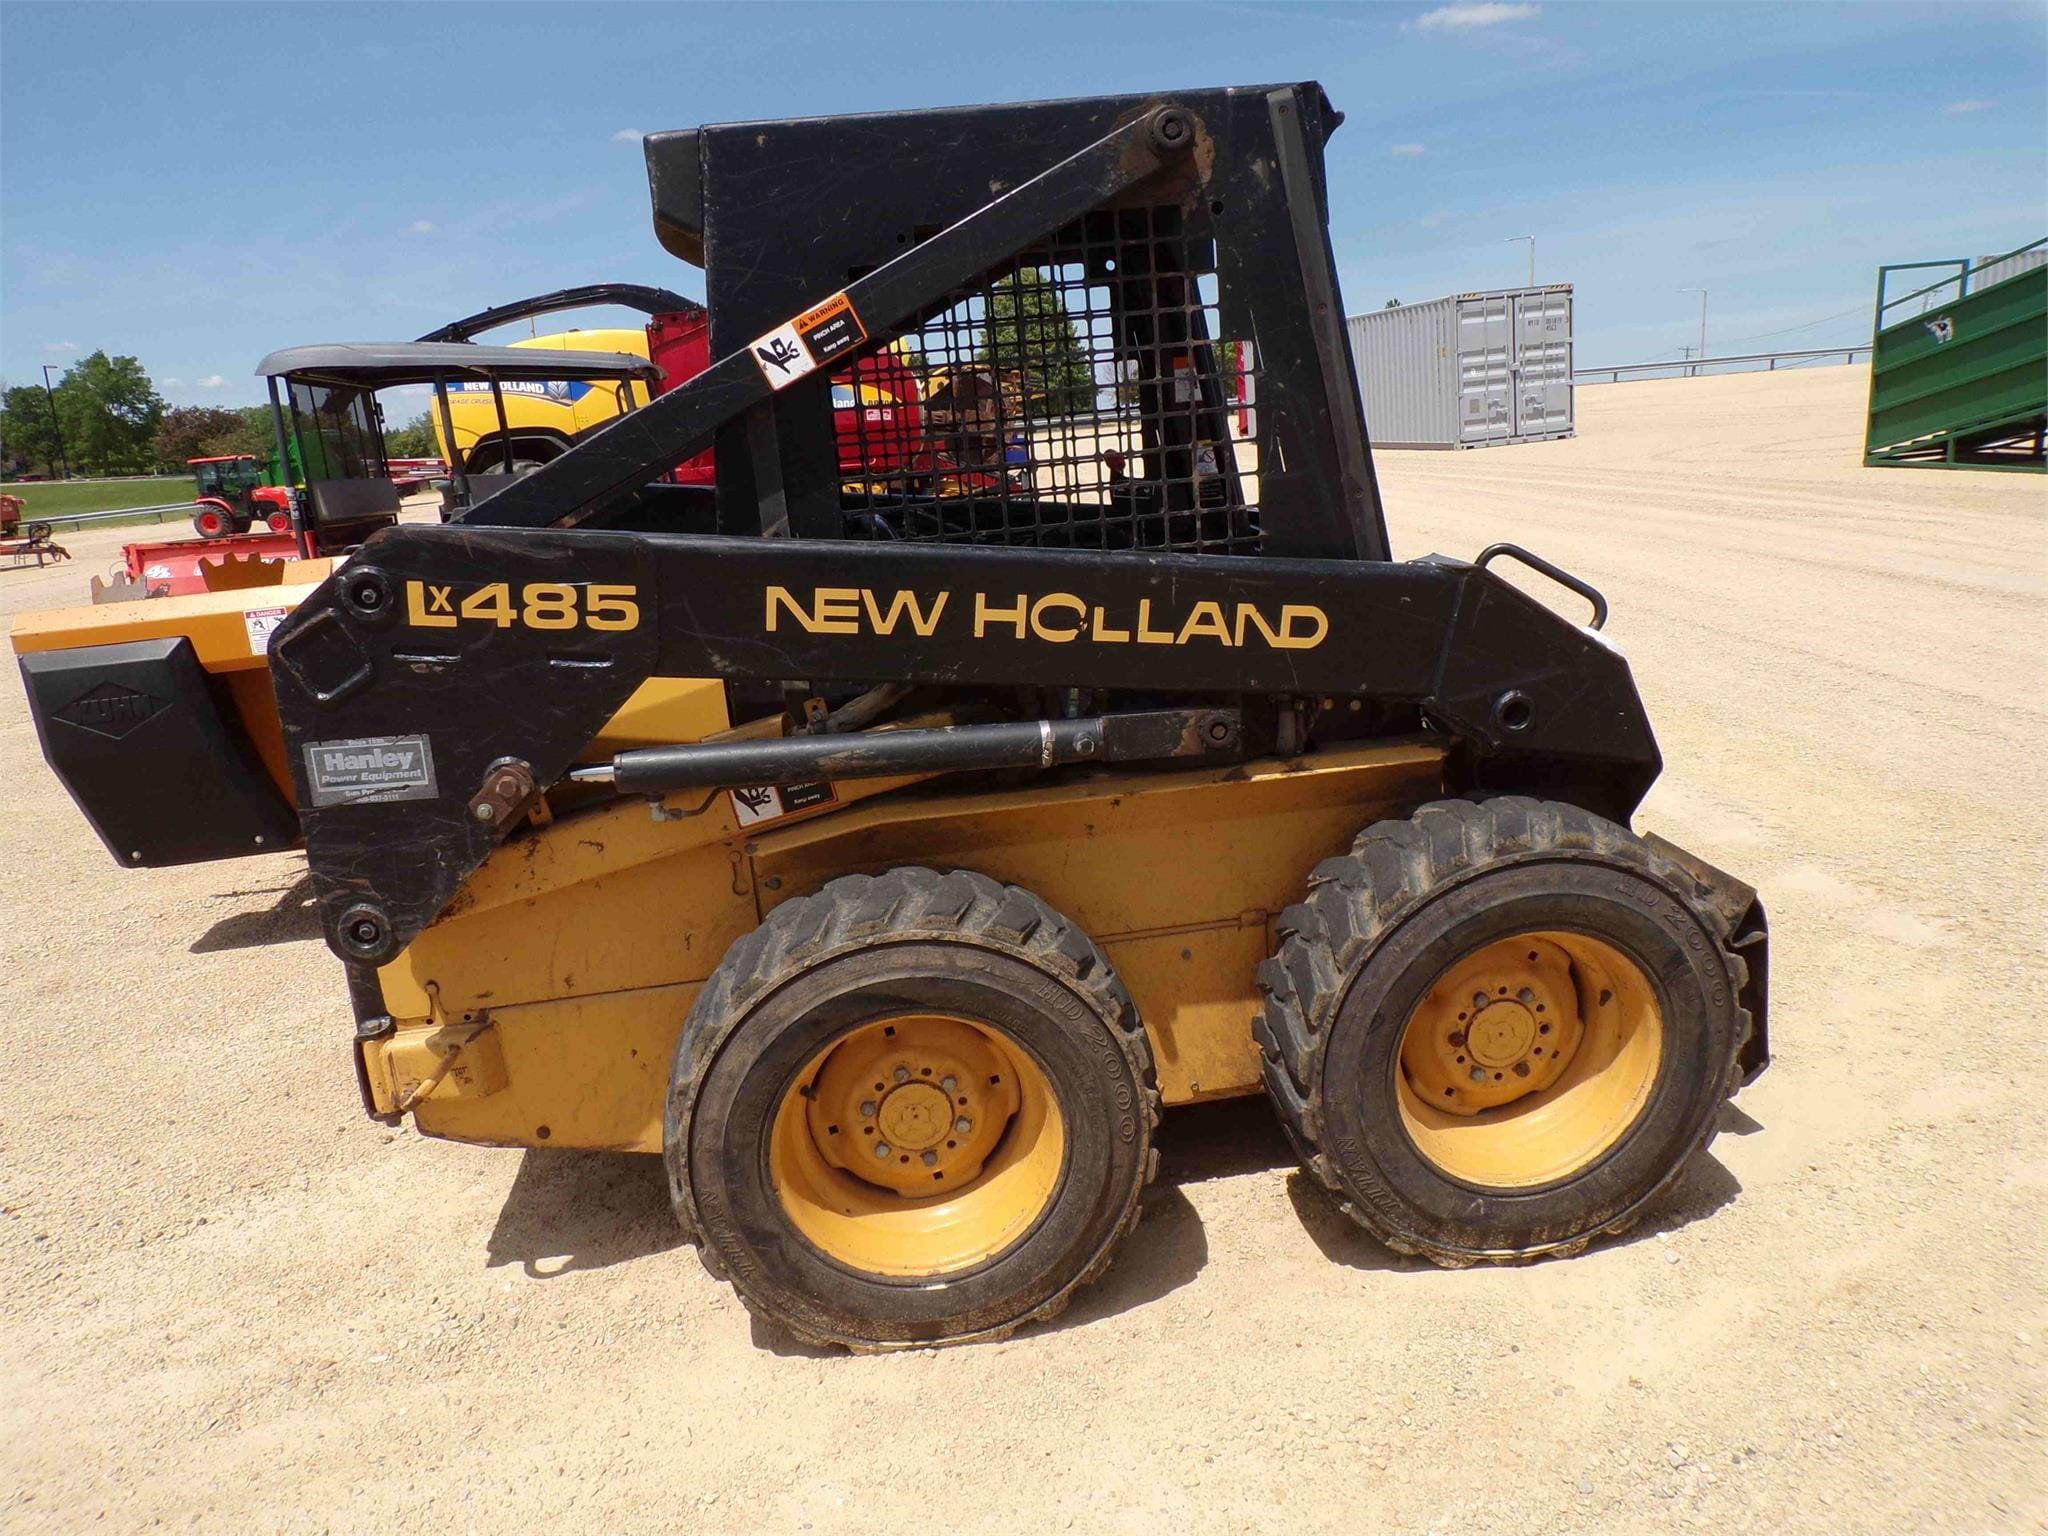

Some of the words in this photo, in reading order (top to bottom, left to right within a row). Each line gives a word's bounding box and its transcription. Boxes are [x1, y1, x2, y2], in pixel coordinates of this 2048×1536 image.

[808, 298, 845, 323] WARNING
[813, 327, 831, 341] PINCH
[829, 319, 845, 333] AREA
[823, 342, 838, 353] Keep
[836, 335, 850, 347] away
[463, 381, 489, 391] NEW
[500, 381, 545, 394] OLLAND
[255, 609, 281, 617] DANGER
[766, 586, 949, 636] NEW
[974, 592, 1329, 649] HOLLAND
[324, 748, 413, 771] Hanley
[321, 774, 358, 784] Power
[361, 768, 421, 782] Equipment
[1033, 980, 1084, 1021] HD
[1081, 1023, 1136, 1143] 2000
